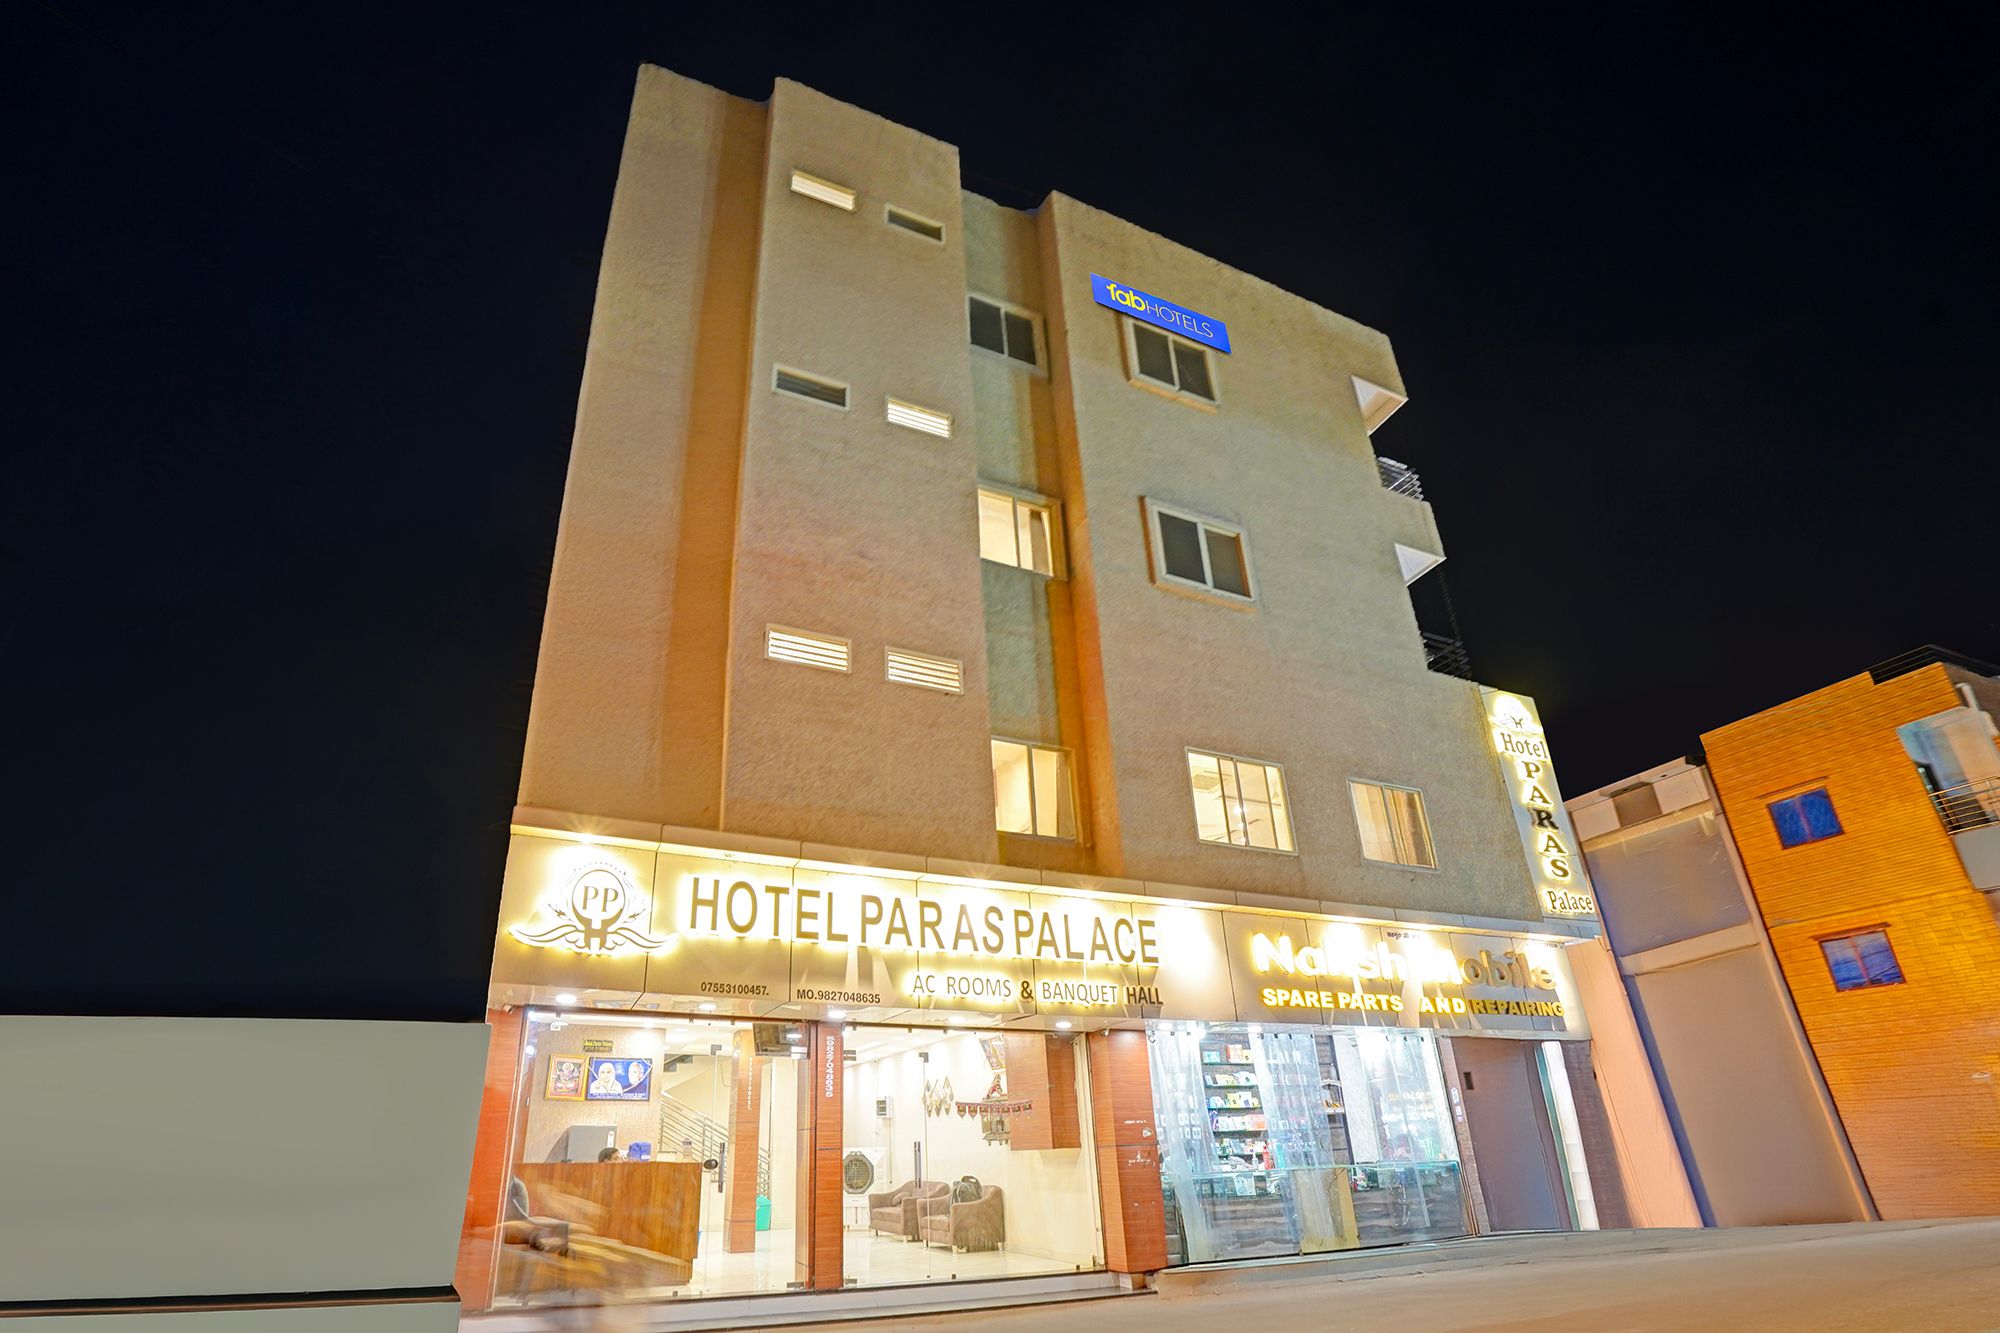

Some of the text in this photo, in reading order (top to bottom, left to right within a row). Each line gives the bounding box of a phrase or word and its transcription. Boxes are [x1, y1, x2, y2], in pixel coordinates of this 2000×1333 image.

[1106, 283, 1214, 338] fabHOTELS
[1501, 732, 1549, 759] Hotel
[1521, 761, 1569, 878] PARAS
[582, 885, 619, 913] PP
[1547, 890, 1593, 911] Palace
[690, 877, 1160, 964] HOTEL PARAS PALACE
[1252, 932, 1408, 982] Nash
[913, 974, 1163, 1007] AC ROOMS & BANQUET HALL
[1262, 988, 1565, 1018] SPARE PARTS AND REPAIRING
